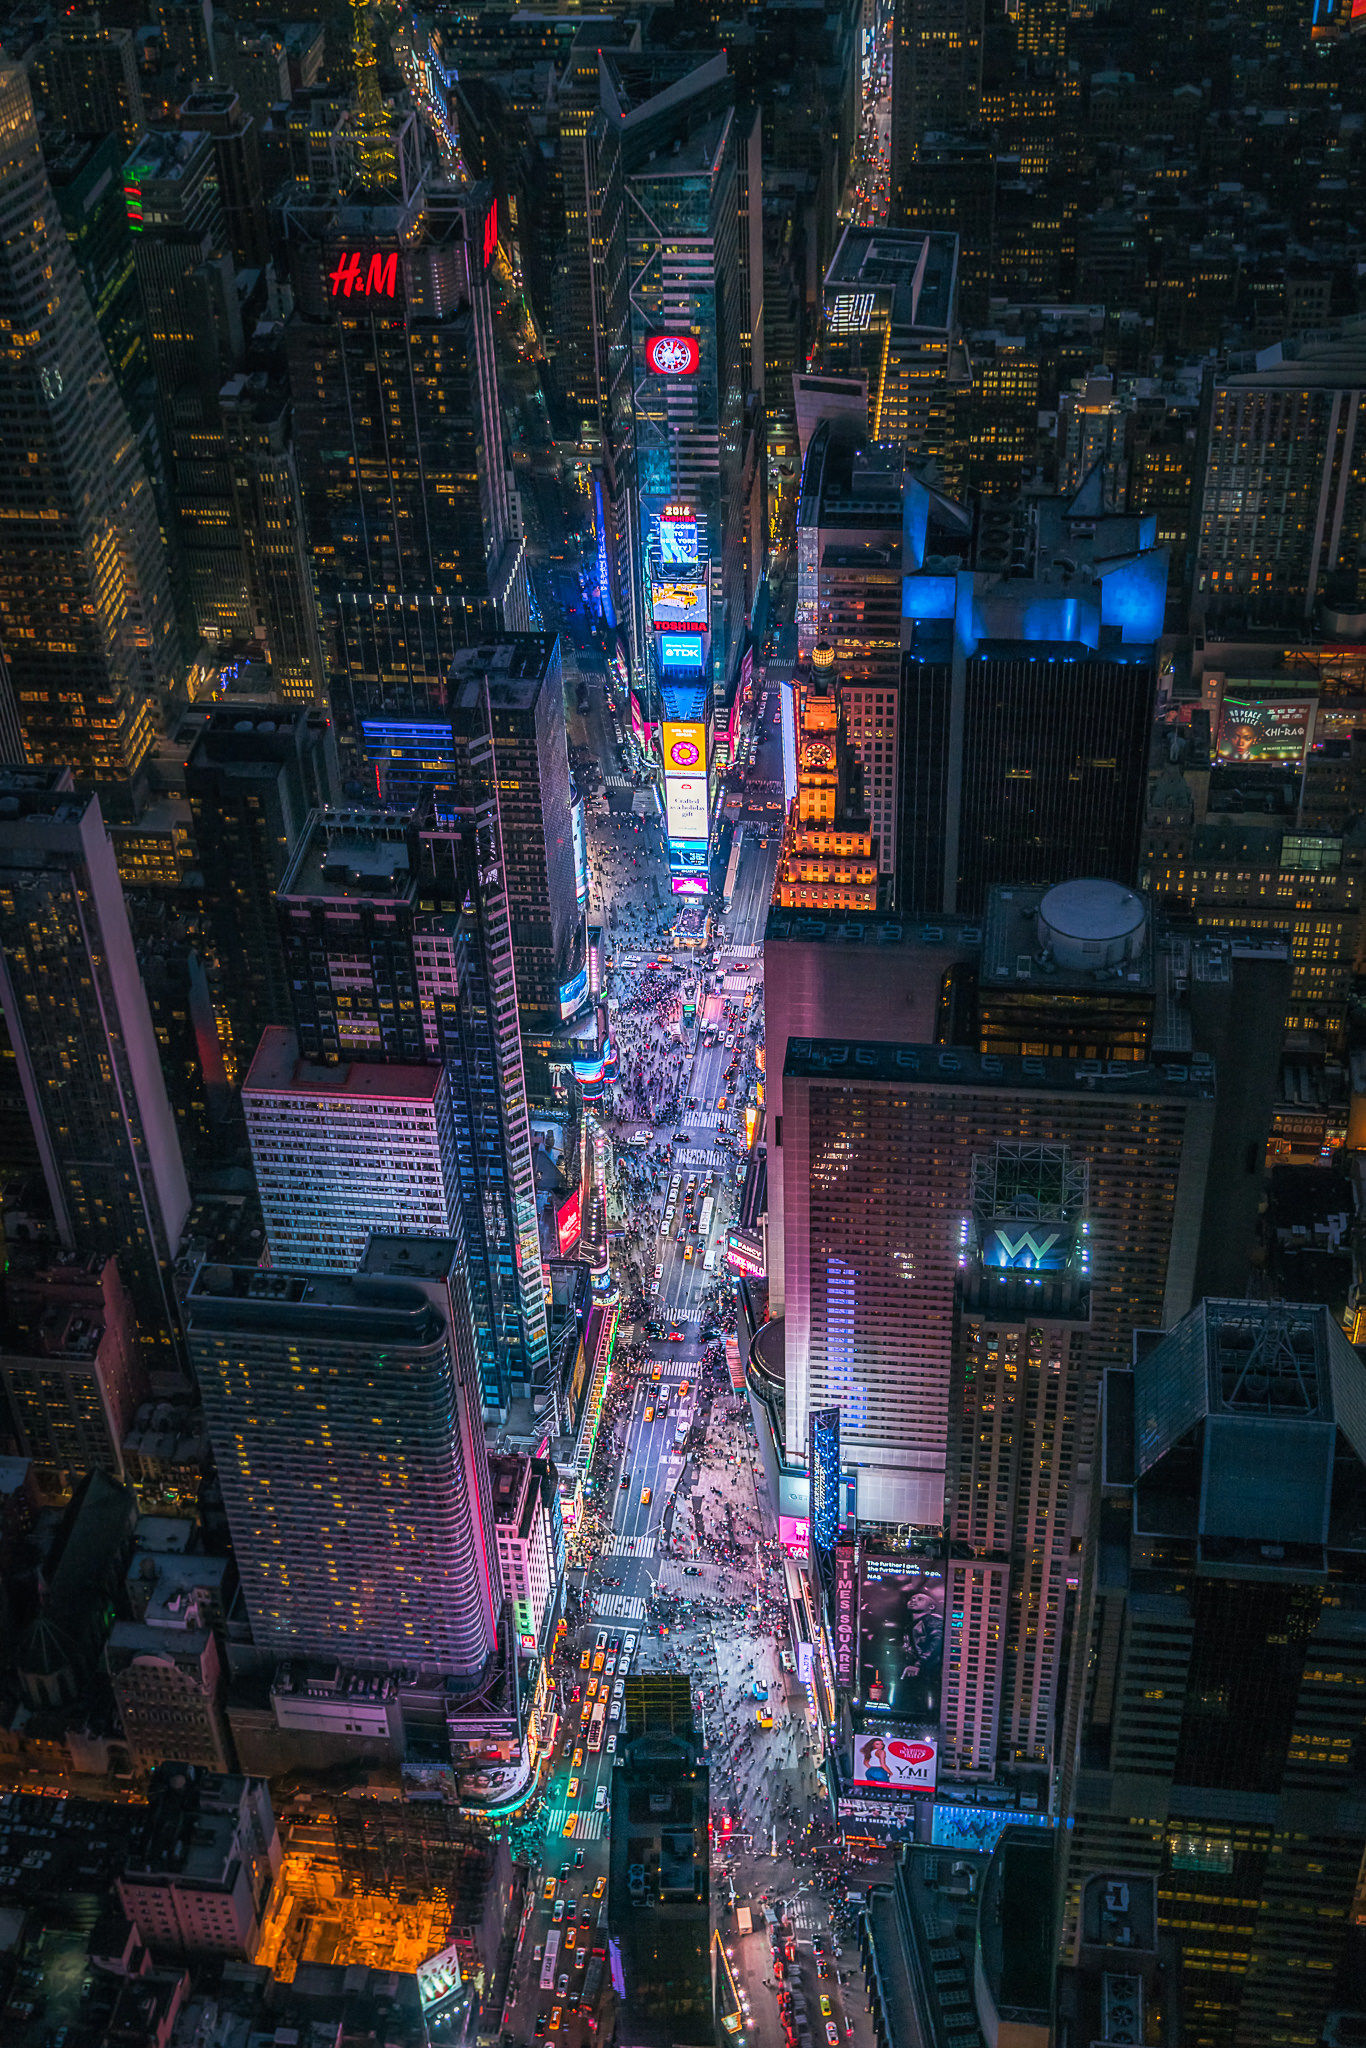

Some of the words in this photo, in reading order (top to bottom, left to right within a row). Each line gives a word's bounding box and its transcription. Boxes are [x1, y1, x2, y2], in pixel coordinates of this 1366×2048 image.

[329, 252, 398, 298] H&M
[665, 506, 690, 516] 2016
[653, 620, 708, 631] TOSHIBA
[673, 649, 699, 658] TDK
[1229, 709, 1239, 717] NO
[1240, 710, 1262, 720] PEACE
[1240, 717, 1258, 726] PIECE
[1264, 727, 1305, 737] CHI-RAQ
[994, 1230, 1060, 1260] W
[838, 1560, 853, 1609] TIMES
[838, 1614, 853, 1673] SQUARE
[895, 1766, 927, 1778] YMI
